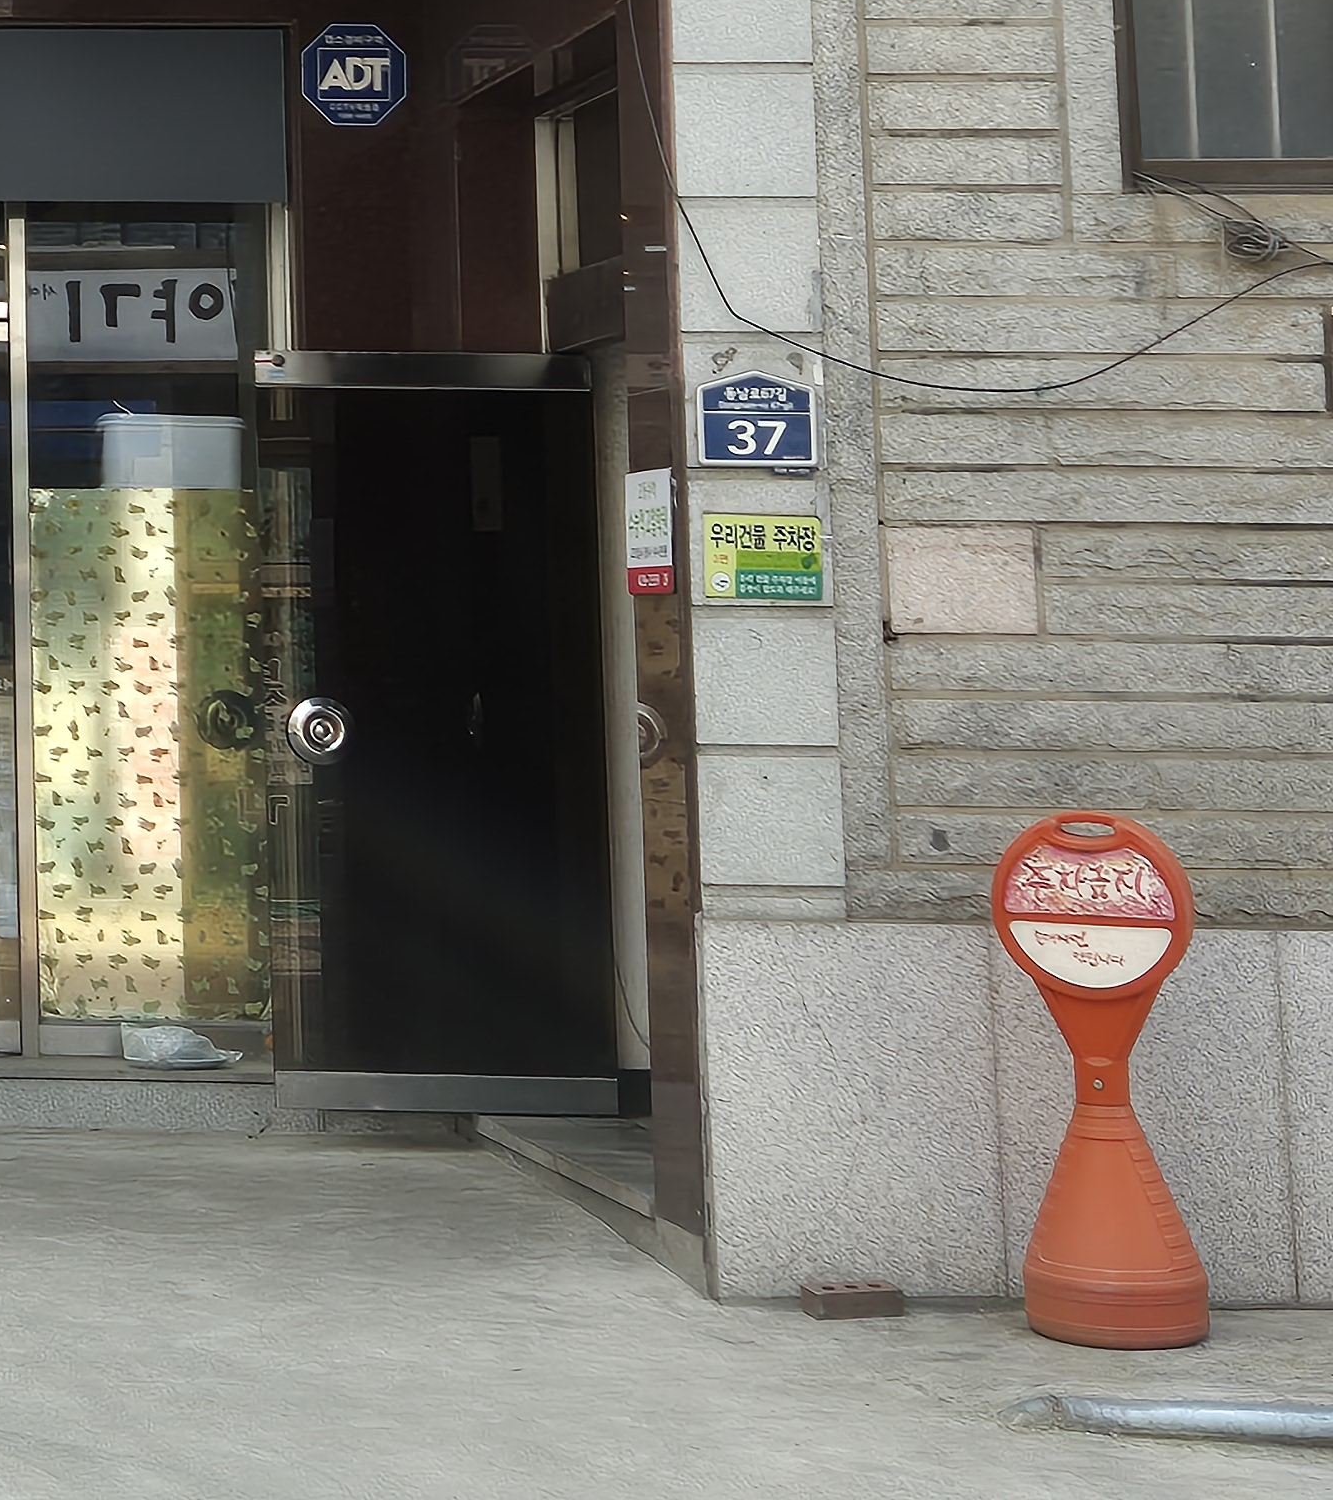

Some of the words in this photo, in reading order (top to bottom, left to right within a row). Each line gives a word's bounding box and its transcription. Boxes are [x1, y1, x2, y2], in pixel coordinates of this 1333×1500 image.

[317, 56, 390, 92] ADT
[727, 419, 787, 456] 37
[711, 523, 766, 550] 우리건물
[772, 525, 816, 552] 주차장
